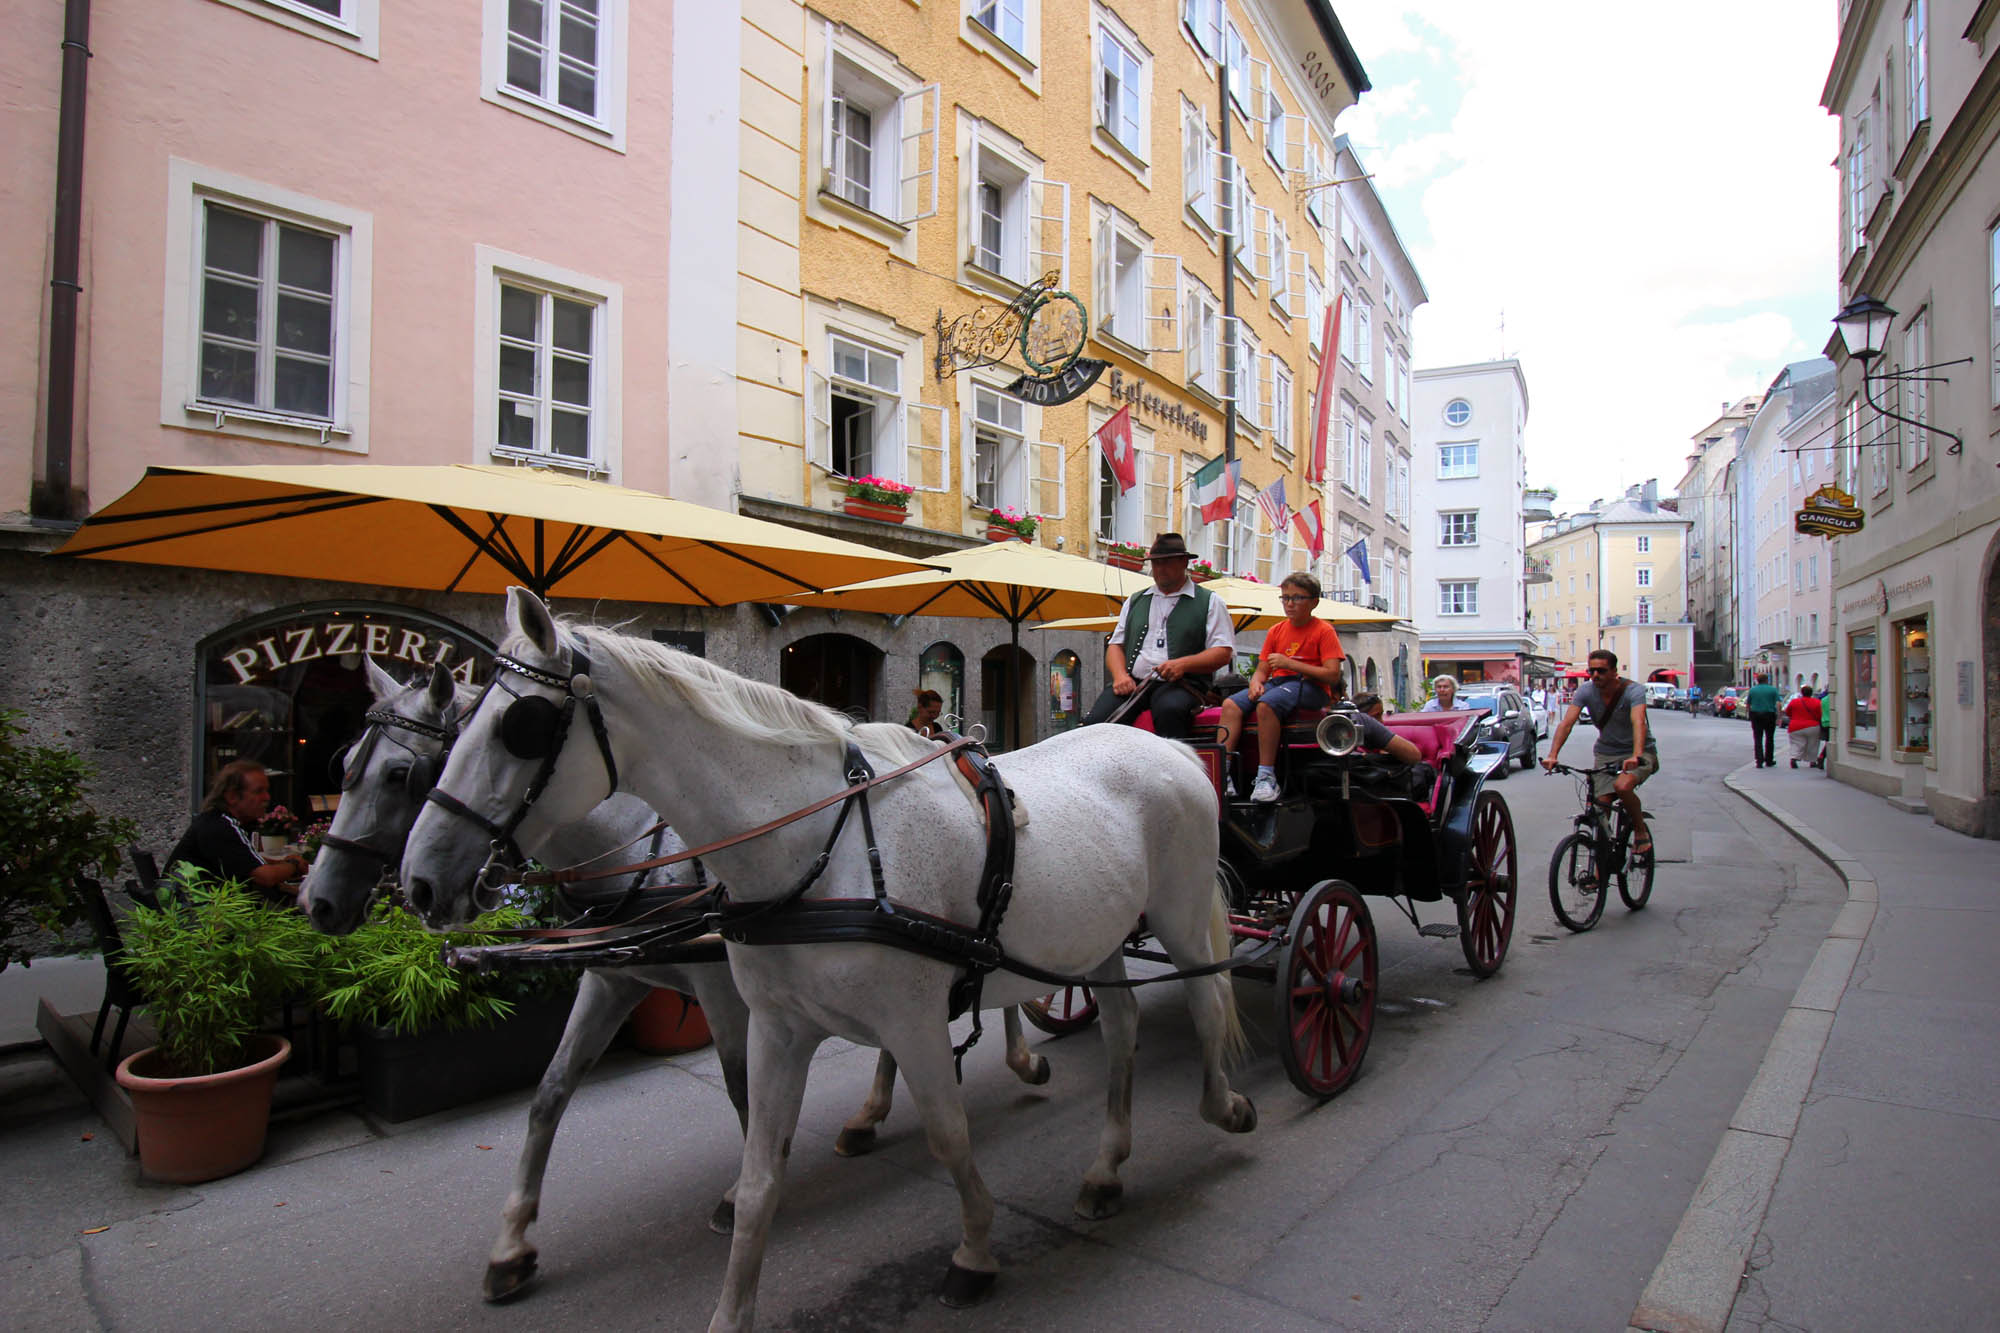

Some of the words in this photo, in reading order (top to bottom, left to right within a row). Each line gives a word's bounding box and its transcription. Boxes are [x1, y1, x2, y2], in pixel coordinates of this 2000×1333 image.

[1301, 51, 1335, 98] 2008
[1021, 365, 1092, 401] HOTEL
[1799, 514, 1857, 528] CANICULA
[223, 623, 476, 685] PIZZERIA
